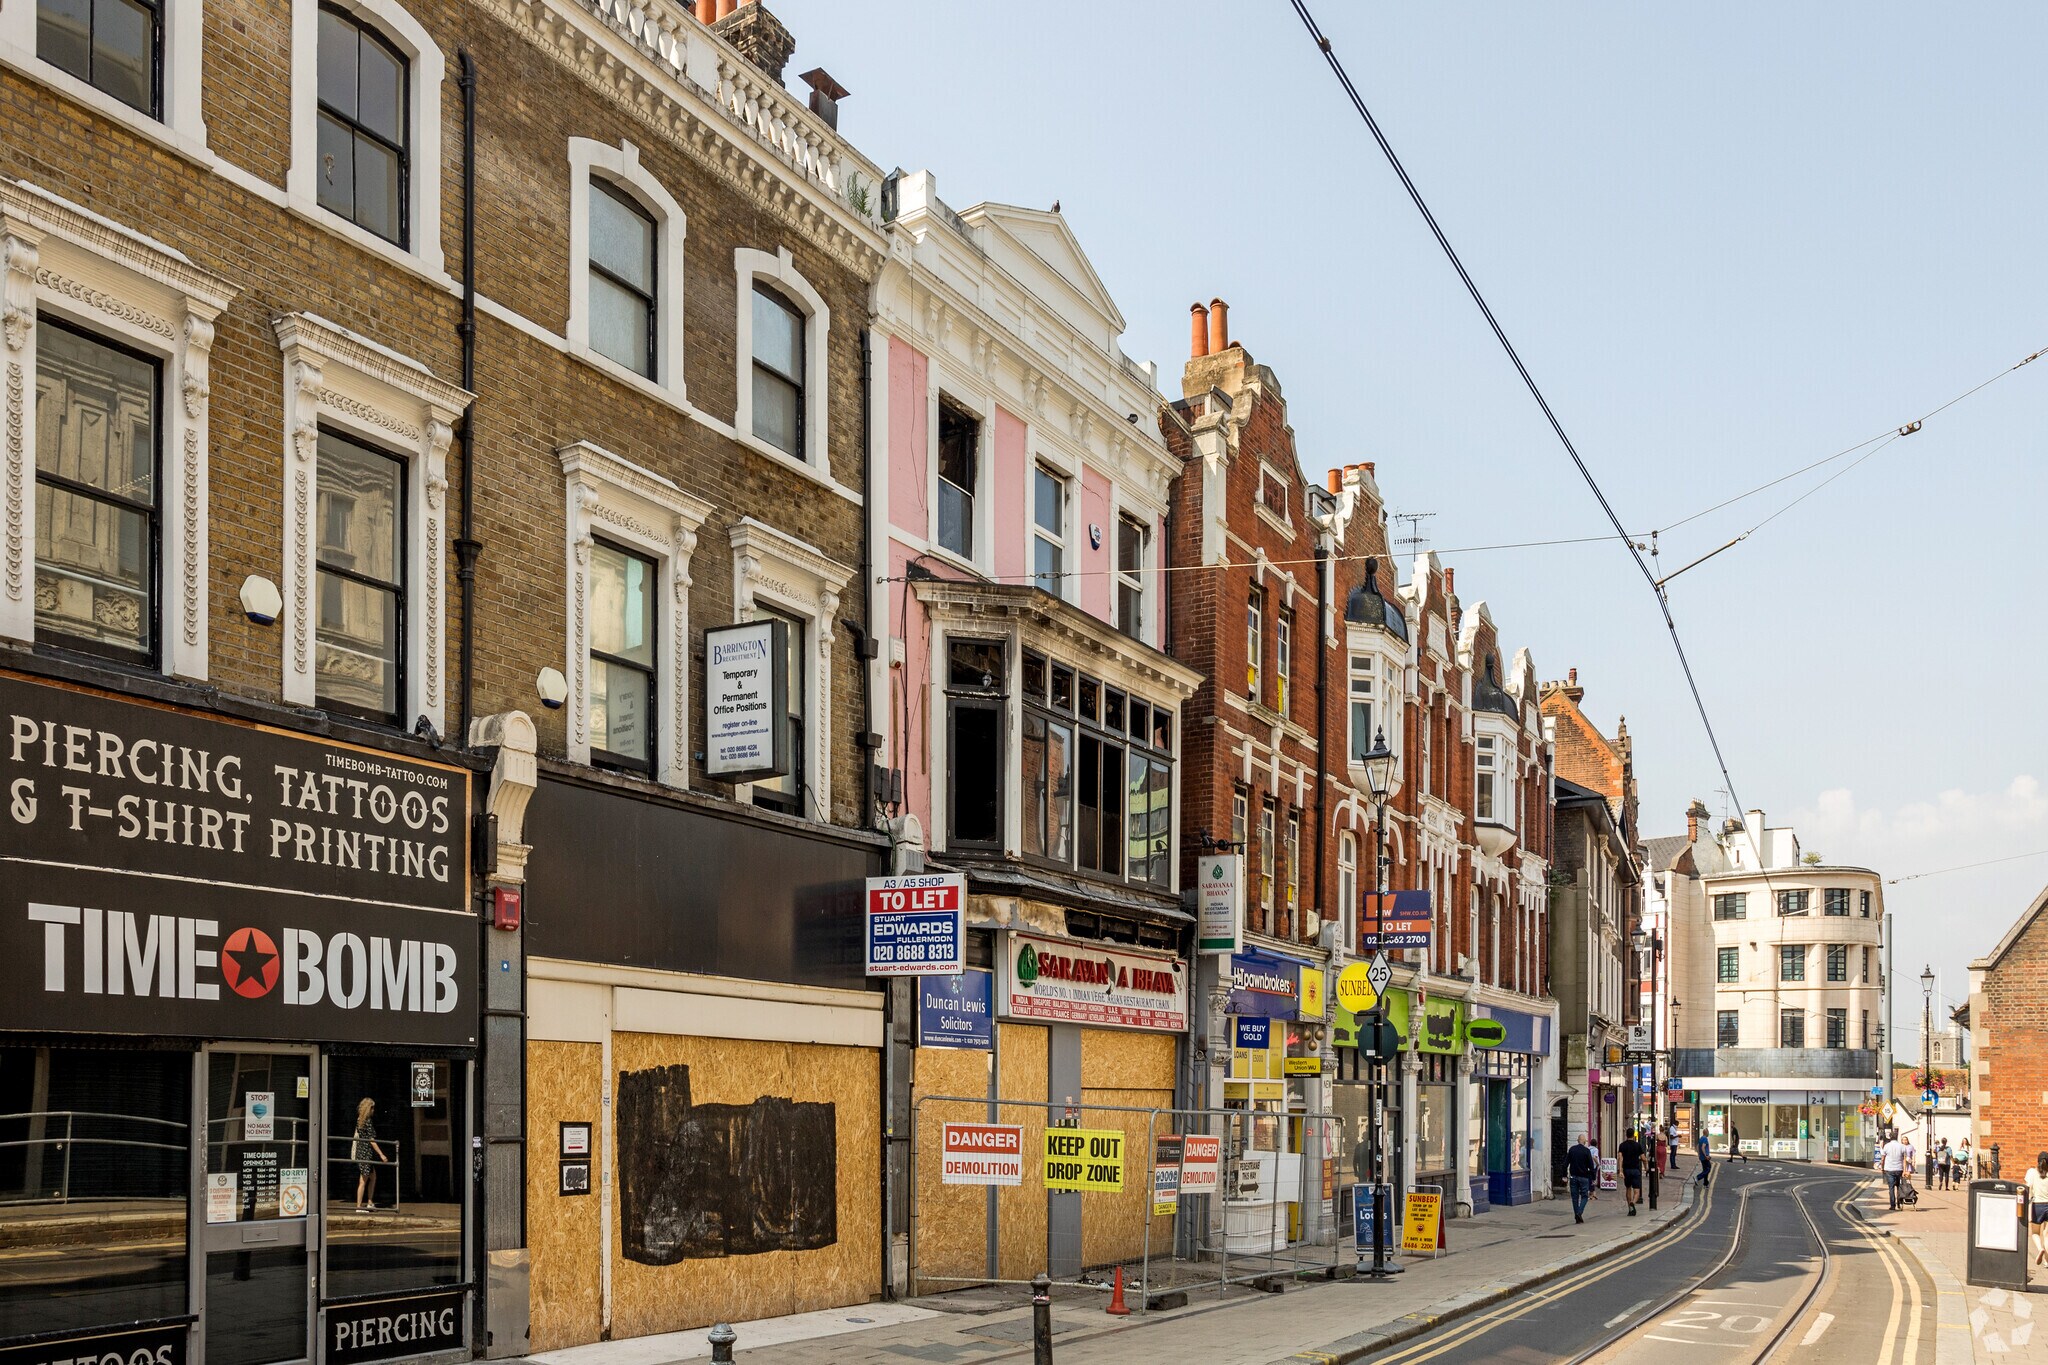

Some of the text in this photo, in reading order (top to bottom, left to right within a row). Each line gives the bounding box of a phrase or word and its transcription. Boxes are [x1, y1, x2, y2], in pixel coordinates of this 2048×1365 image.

[714, 639, 766, 665] BARRINGTON
[723, 653, 756, 662] RECRUITMENT
[722, 669, 758, 680] Temporary
[737, 681, 742, 690] &
[722, 691, 758, 702] Permanent
[714, 702, 766, 714] Office Positions
[722, 720, 740, 730] register
[9, 714, 449, 834] PIERCING, TATTOOS
[325, 753, 448, 790] TIMEBOMB-TATTOO.COM
[10, 777, 449, 883] & T-SHIRT PRINTING
[884, 878, 944, 888] A3 A5 SHOP
[880, 890, 948, 910] TO LET
[874, 922, 953, 936] EDWARDS
[1382, 922, 1412, 932] TO LET
[28, 902, 459, 1013] TIME BOMB
[874, 944, 954, 961] 020 8688 8313
[1372, 968, 1386, 981] 25
[1244, 973, 1290, 993] pawnbrokers
[926, 993, 986, 1013] Duncan Lewis
[1034, 982, 1170, 1010] WORLD'S NO. INDIAN VEGEARIAN RESTAURANT CHAIN
[1014, 1006, 1031, 1015] KUWAIT
[1054, 1009, 1070, 1018] FRANCE
[1071, 1012, 1087, 1020] GERMANY
[1107, 1015, 1121, 1023] CANADA
[1016, 996, 1028, 1005] INDIA
[1033, 997, 1051, 1007] SINGAPORE
[1053, 999, 1069, 1009] MALAYSIA
[1071, 1002, 1087, 1011] THAILAND
[1168, 1012, 1183, 1020] BAHRAIN
[941, 1016, 972, 1031] Solicitors
[1234, 1051, 1248, 1059] LOANS
[1732, 1094, 1766, 1104] Foxtons
[950, 1131, 1017, 1148] DANGER
[1048, 1136, 1120, 1158] KEEP OUT
[1186, 1143, 1217, 1157] DANGER
[946, 1162, 1019, 1176] DEMOLITION
[1047, 1162, 1120, 1183] DROP ZONE
[1240, 1161, 1260, 1171] PEDESTRIANS
[1182, 1171, 1216, 1184] DEMOLITION
[1409, 1195, 1438, 1203] SUNBEDS
[1660, 1310, 1774, 1333] 20
[336, 1308, 454, 1351] PIERCING
